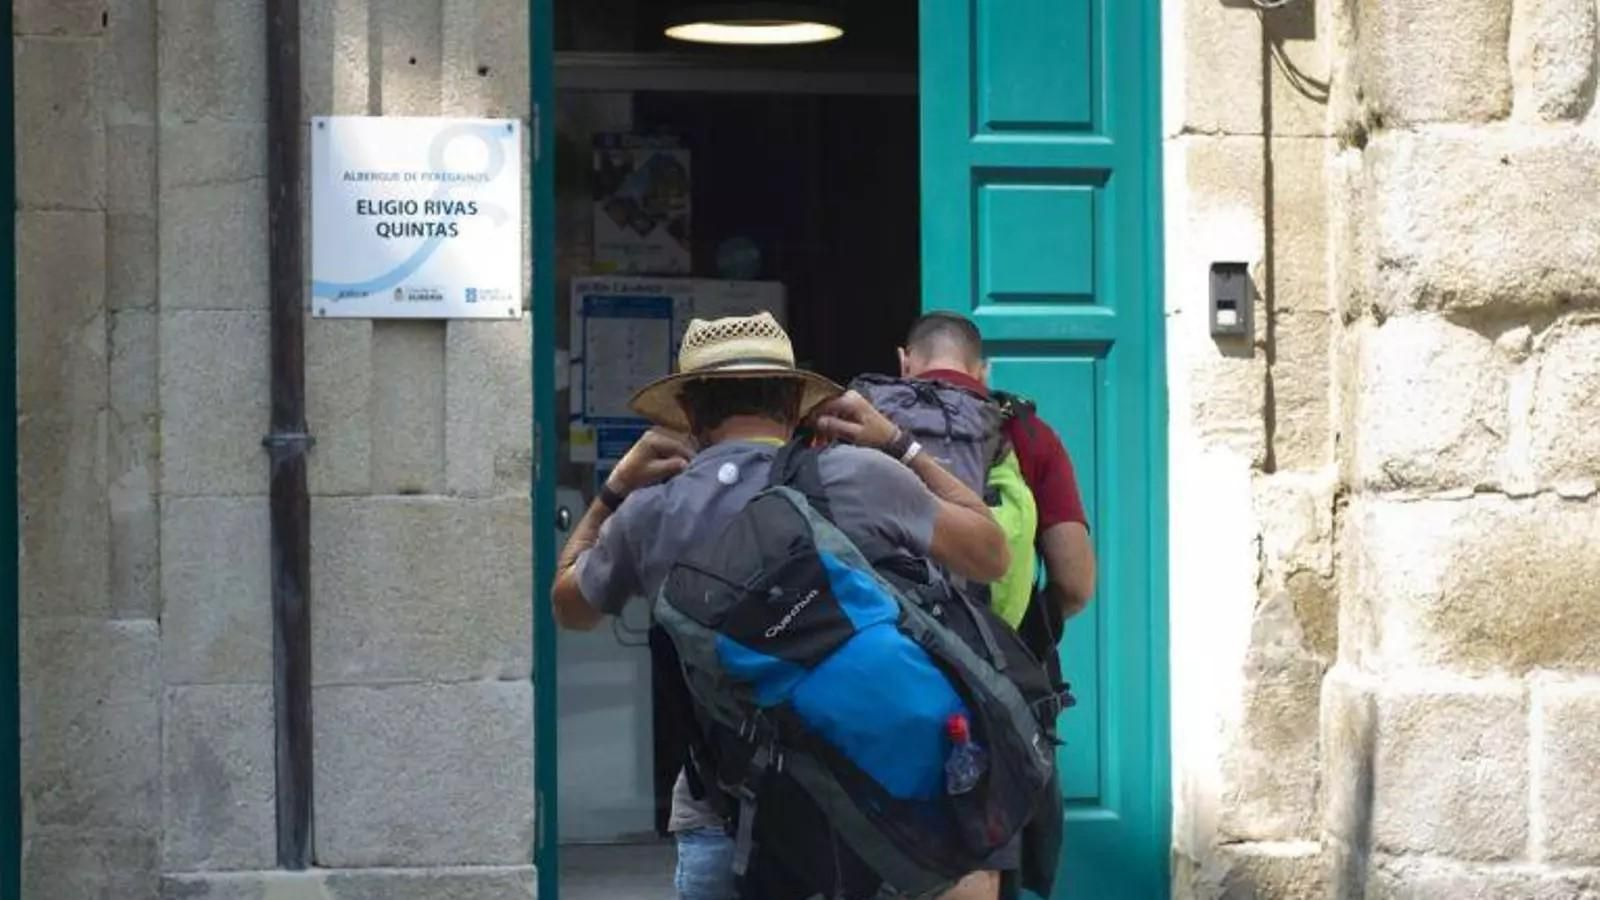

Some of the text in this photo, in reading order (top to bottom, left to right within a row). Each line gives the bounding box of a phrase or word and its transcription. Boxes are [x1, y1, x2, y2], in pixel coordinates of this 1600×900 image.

[343, 171, 399, 182] ALBERGUE
[404, 172, 417, 182] DE
[356, 199, 478, 216] ELIGIO RIVAS
[376, 222, 459, 239] QUINTAS
